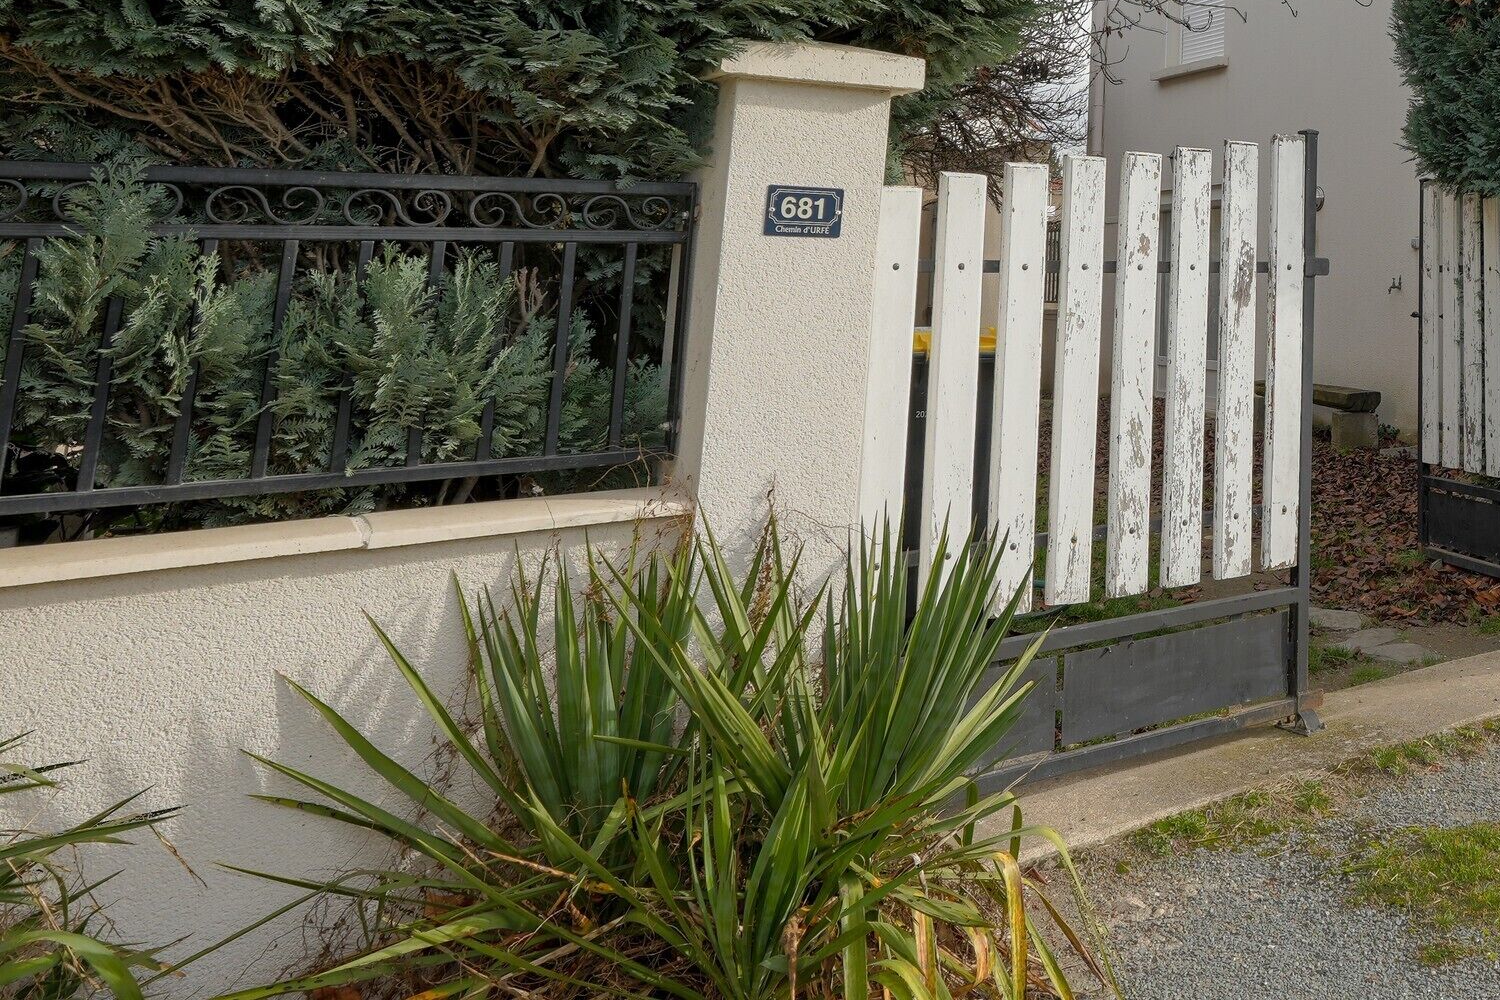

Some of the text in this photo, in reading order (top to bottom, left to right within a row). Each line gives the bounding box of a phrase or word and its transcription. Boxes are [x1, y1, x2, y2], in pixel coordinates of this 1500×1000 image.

[781, 196, 825, 219] 681
[775, 225, 830, 235] Chemin d'URFÉ
